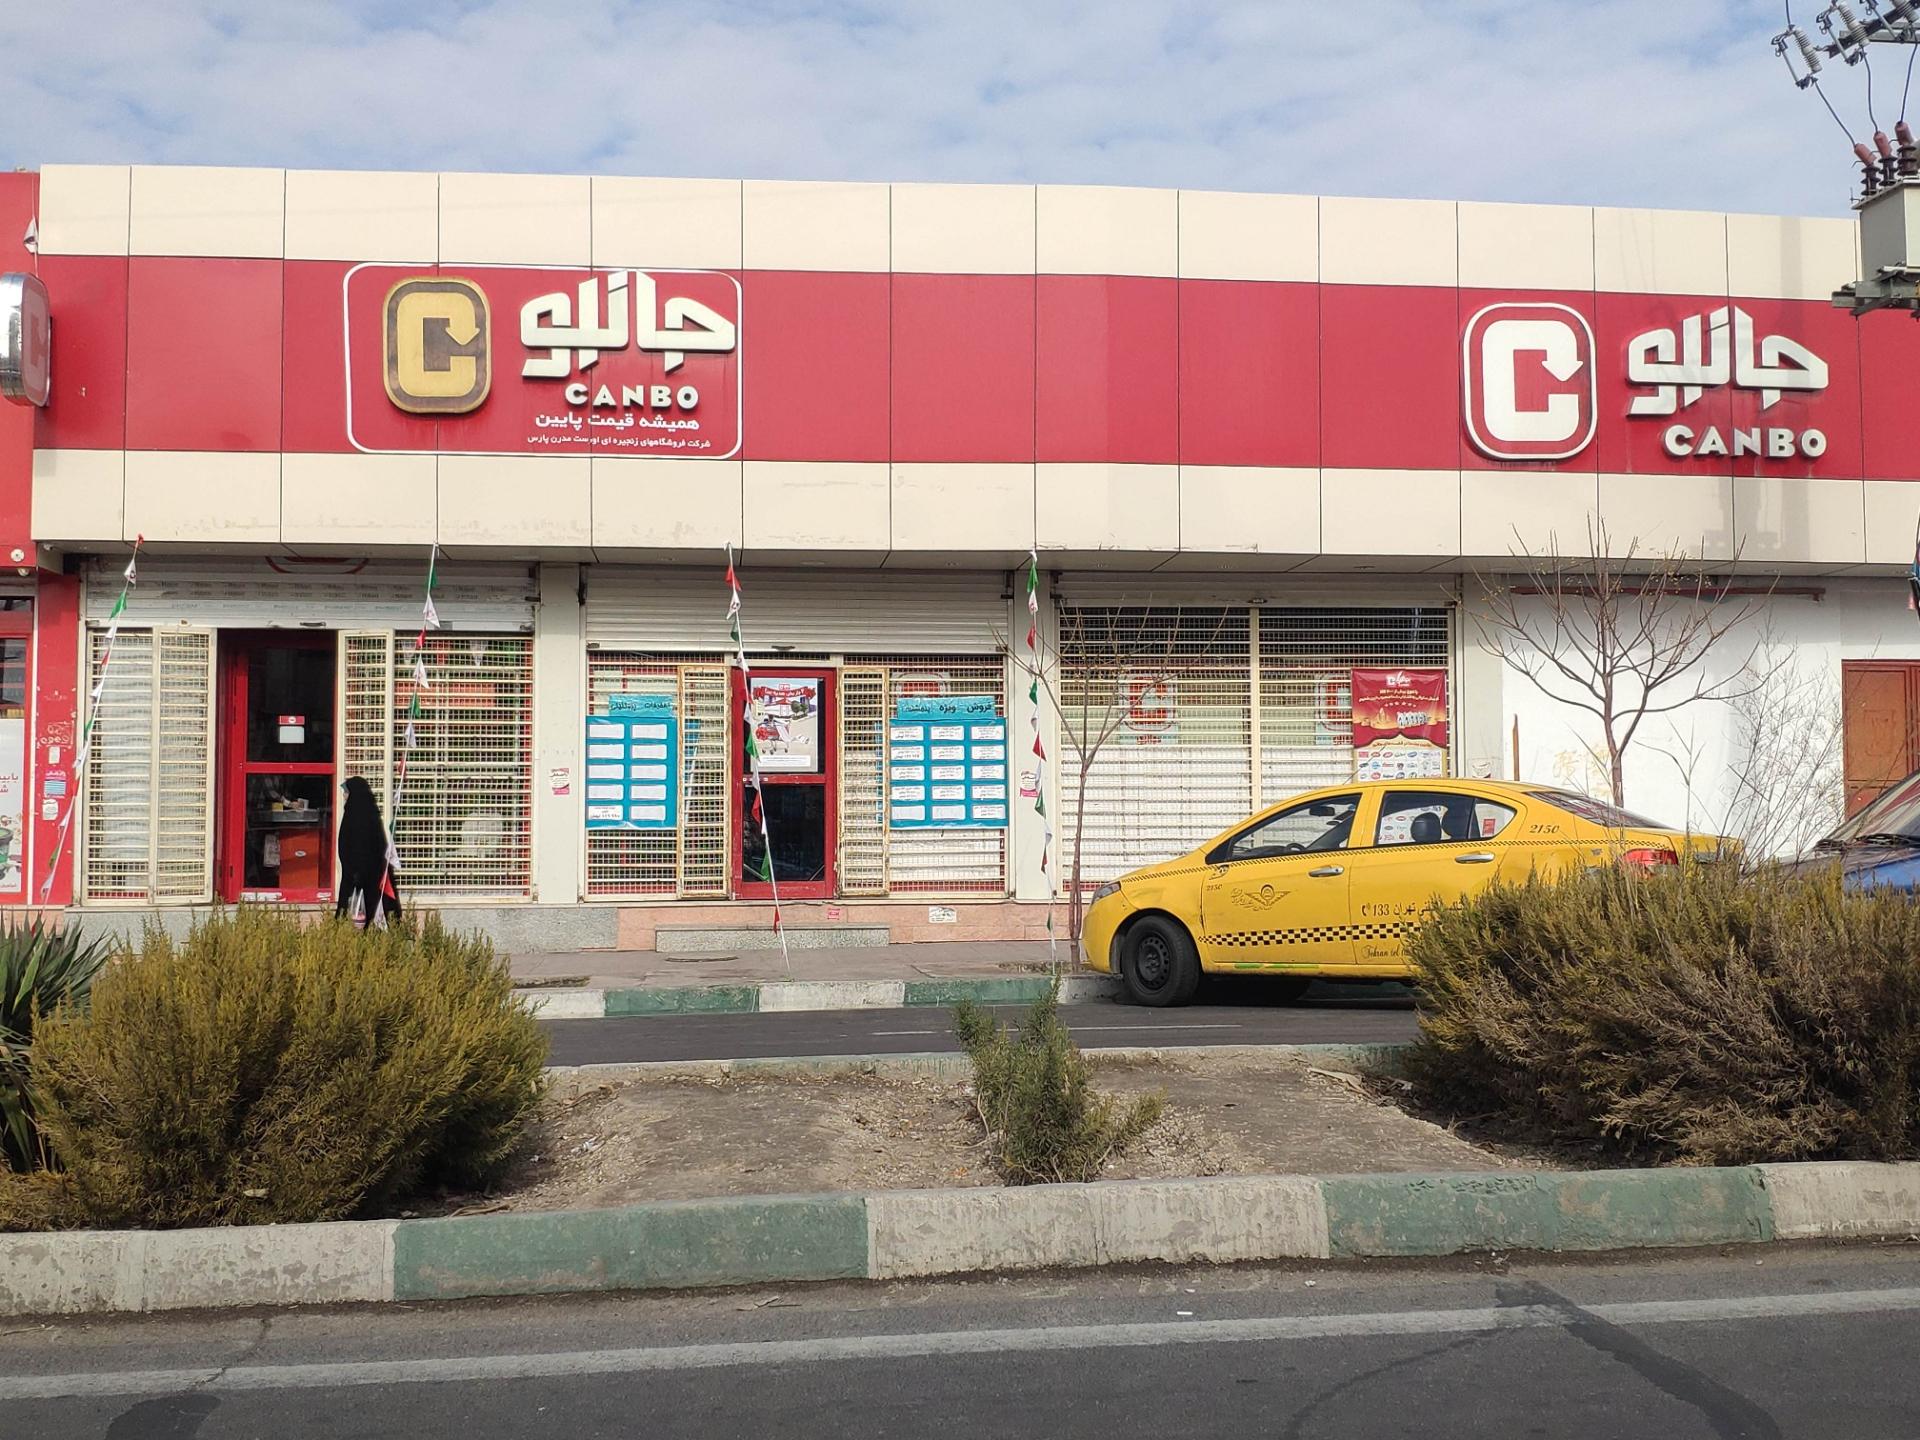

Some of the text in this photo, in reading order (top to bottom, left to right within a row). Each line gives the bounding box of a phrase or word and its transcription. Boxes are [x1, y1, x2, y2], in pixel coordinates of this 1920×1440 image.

[564, 382, 700, 410] CANBO
[534, 411, 700, 432] همیشه قیمت پایین
[527, 434, 549, 444] پارس
[550, 435, 572, 444] مدرن
[613, 437, 640, 447] زنجیره
[687, 438, 711, 449] شرکت
[1662, 424, 1828, 459] CANBO
[938, 703, 956, 714] ویژه
[966, 702, 992, 714] فروش
[1529, 824, 1560, 834] 2150
[1373, 903, 1390, 916] 133
[1393, 902, 1416, 916] تهران
